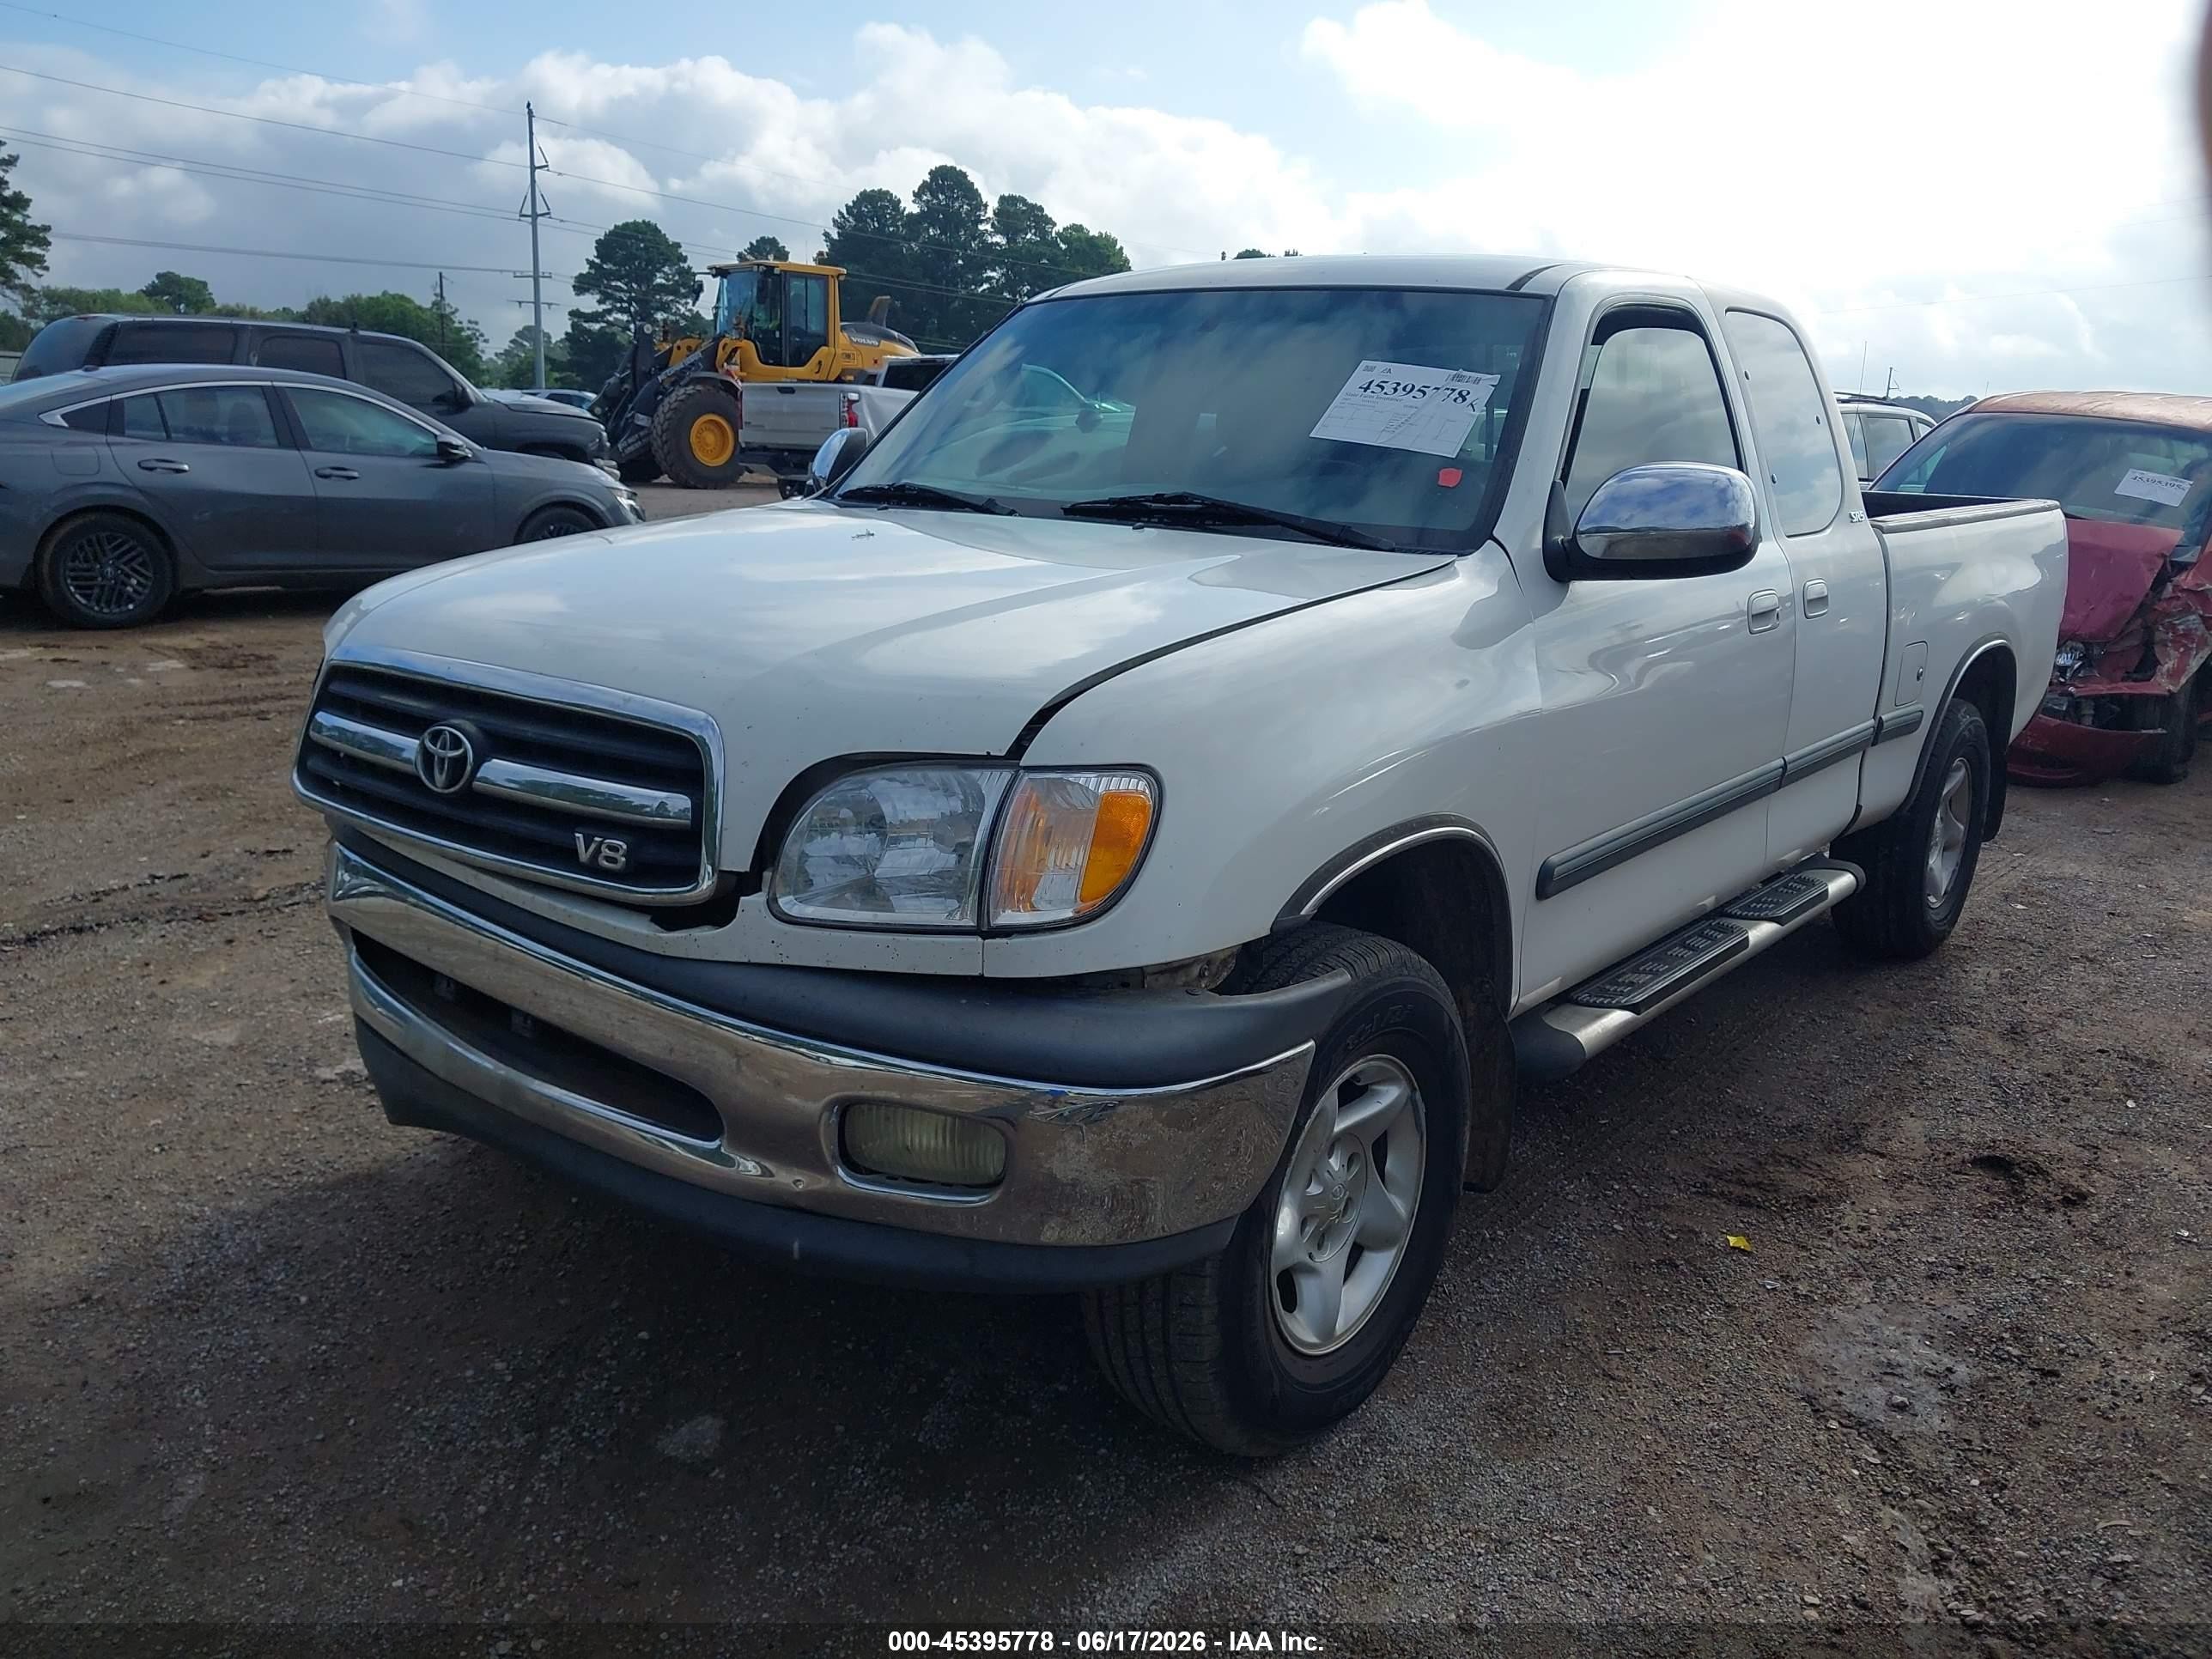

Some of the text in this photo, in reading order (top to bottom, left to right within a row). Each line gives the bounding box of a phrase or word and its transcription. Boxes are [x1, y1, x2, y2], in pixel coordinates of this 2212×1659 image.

[850, 336, 879, 346] VOLVO
[1850, 510, 1865, 523] SR5
[574, 832, 628, 871] V8
